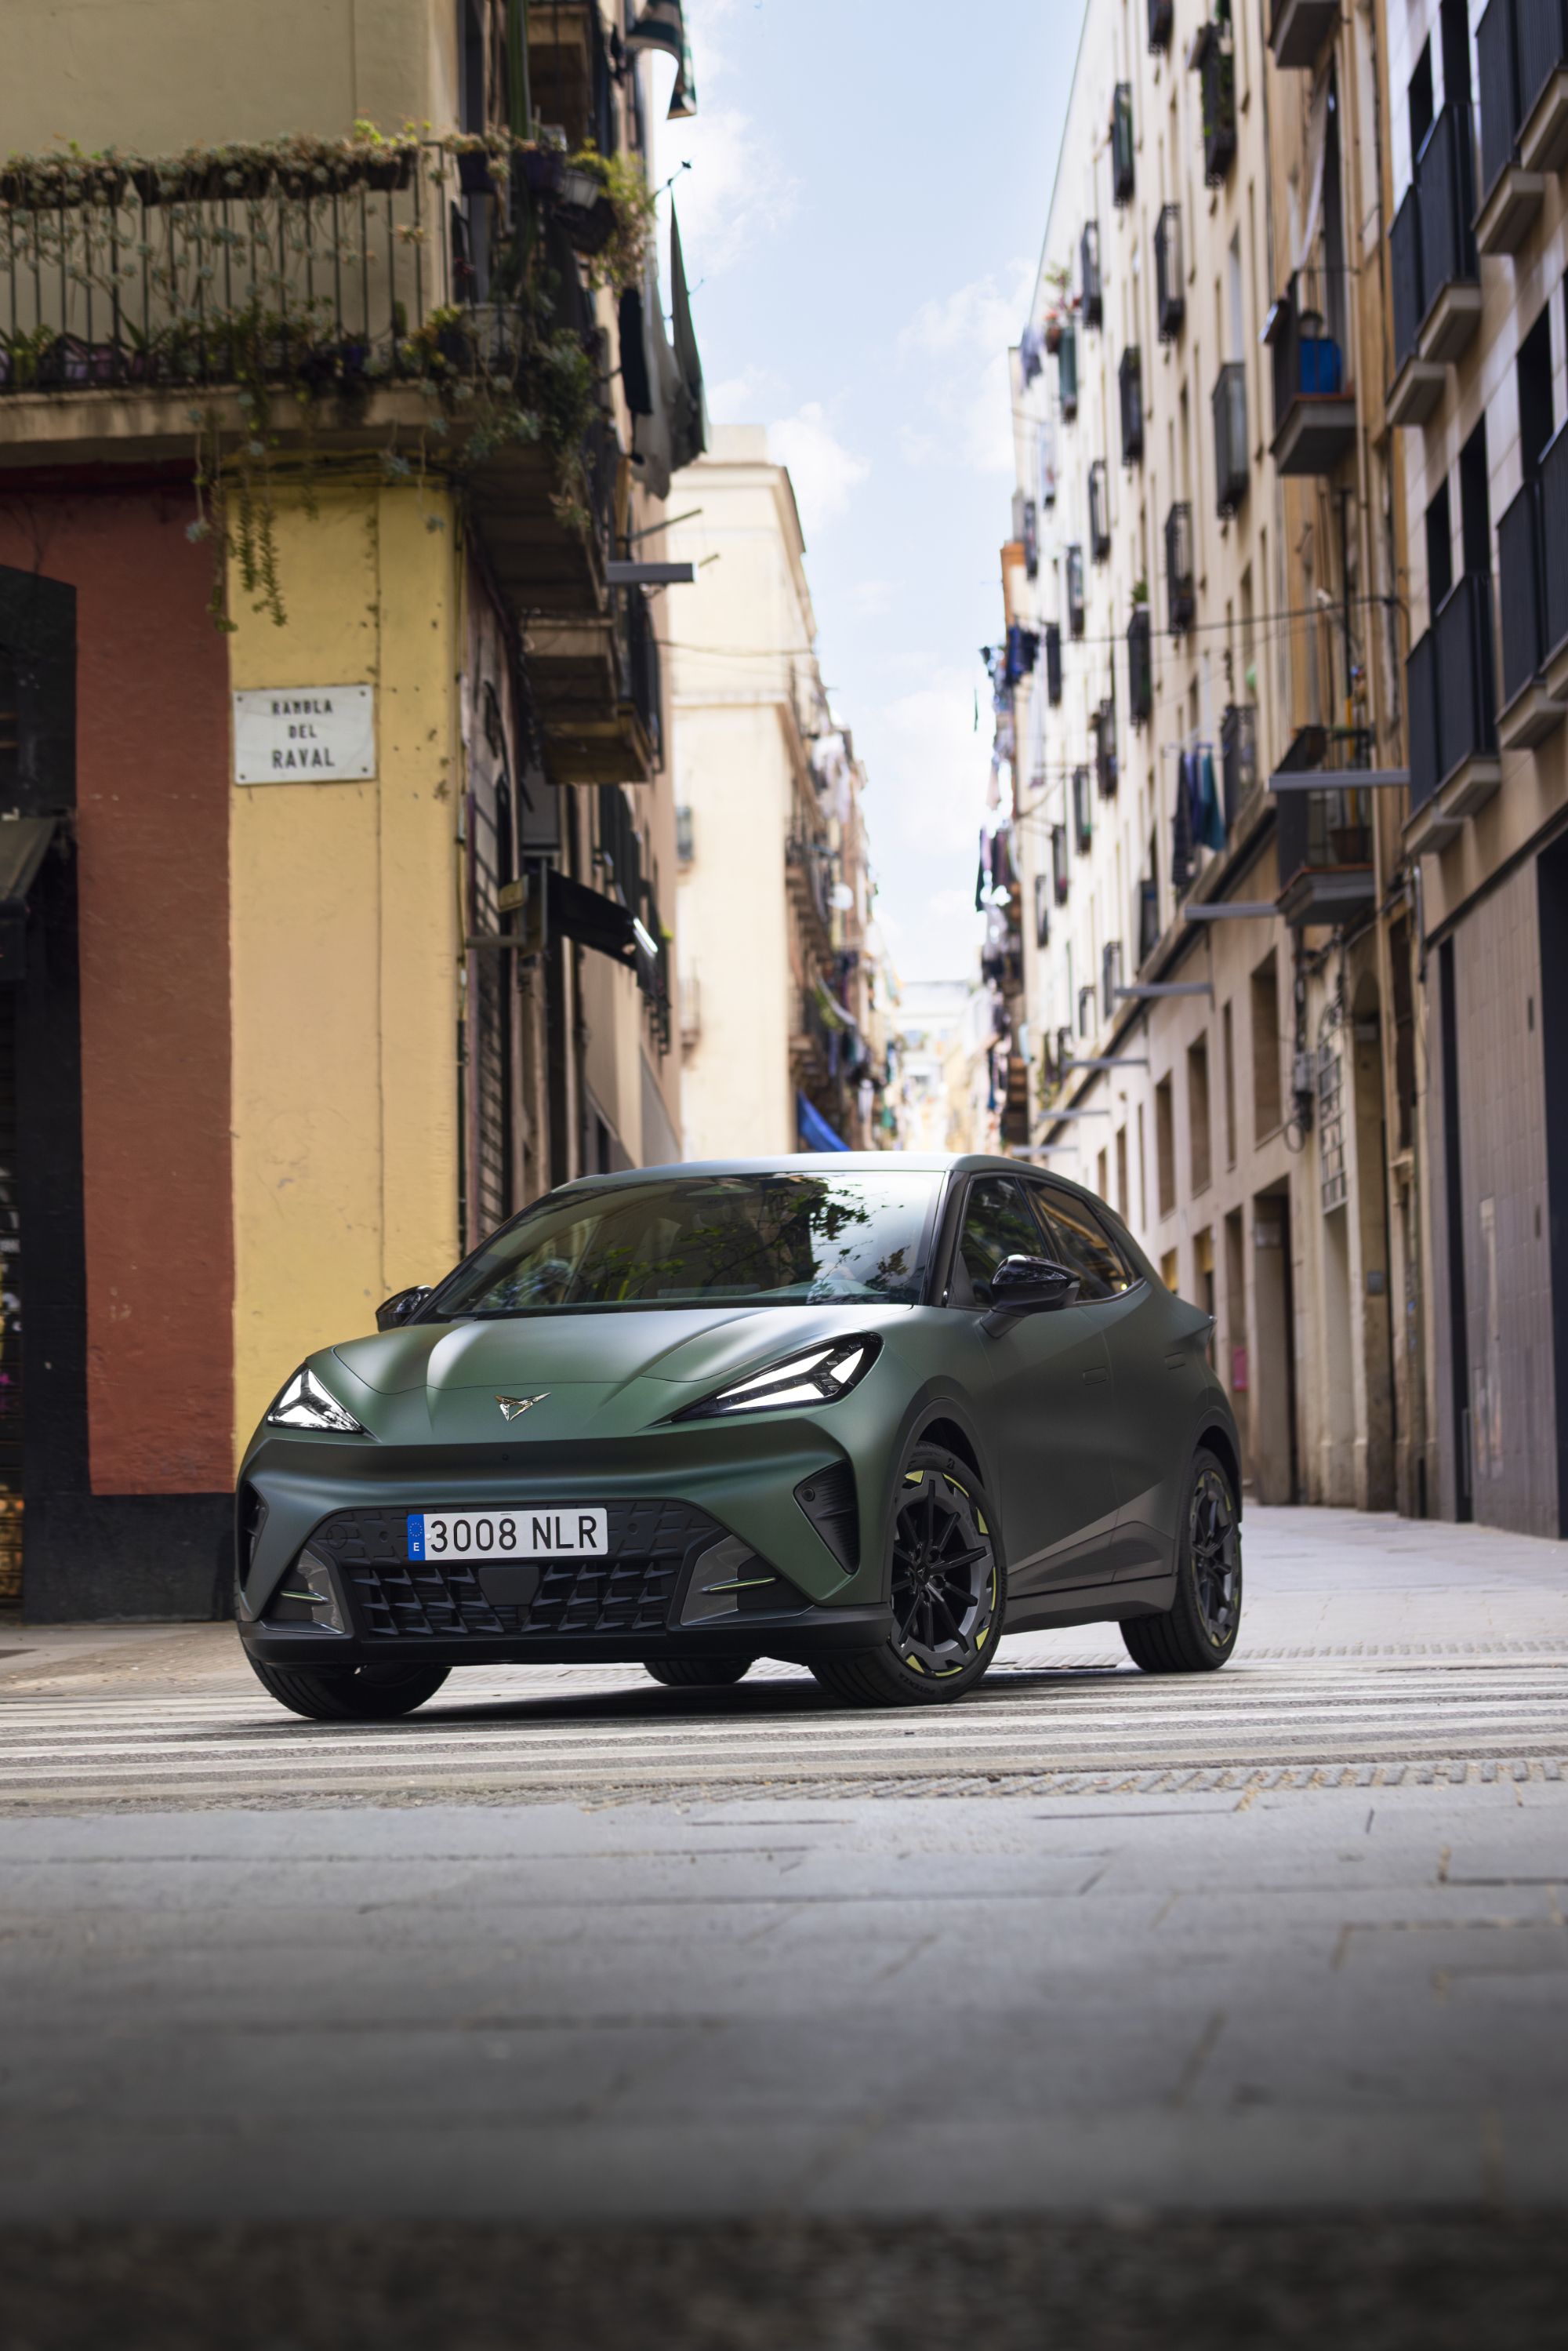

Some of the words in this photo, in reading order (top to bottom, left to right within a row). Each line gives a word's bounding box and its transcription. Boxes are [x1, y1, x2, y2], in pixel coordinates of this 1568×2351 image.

[272, 699, 333, 715] RAMBLA
[289, 724, 317, 739] DEL
[272, 747, 335, 769] RAVAL
[430, 1518, 517, 1553] 3008
[532, 1515, 597, 1550] NLR
[413, 1543, 419, 1551] E
